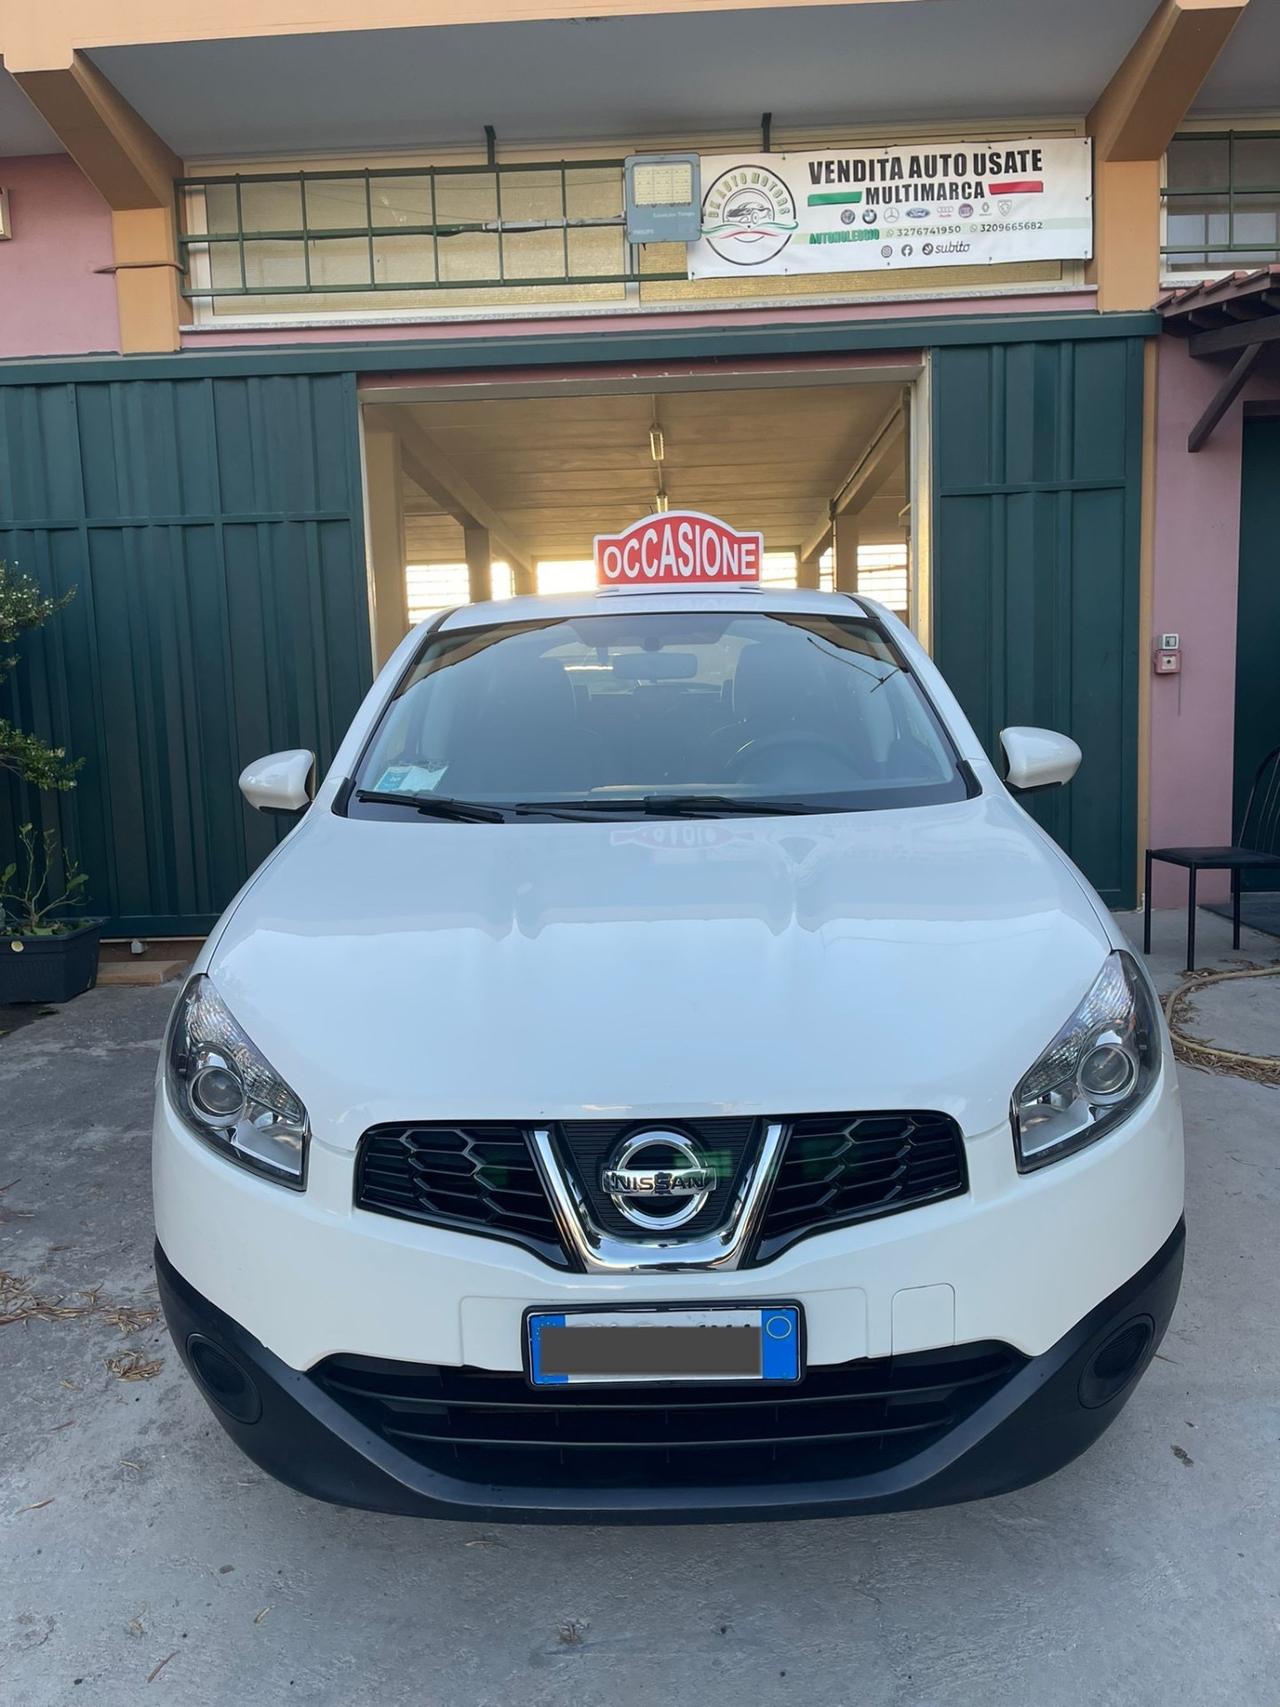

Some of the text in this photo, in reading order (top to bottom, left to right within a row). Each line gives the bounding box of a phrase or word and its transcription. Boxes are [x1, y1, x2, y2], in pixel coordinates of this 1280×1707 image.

[808, 149, 1043, 185] VENDITA AUTO USATE
[715, 172, 748, 200] AUTO
[751, 171, 791, 216] MOTORS
[865, 181, 985, 205] MULTIMARCA
[897, 225, 961, 237] 3276741950
[980, 221, 1044, 233] 3209665682
[934, 240, 971, 254] subito
[602, 521, 757, 579] OCCASIONE
[615, 1176, 704, 1191] NISSAN
